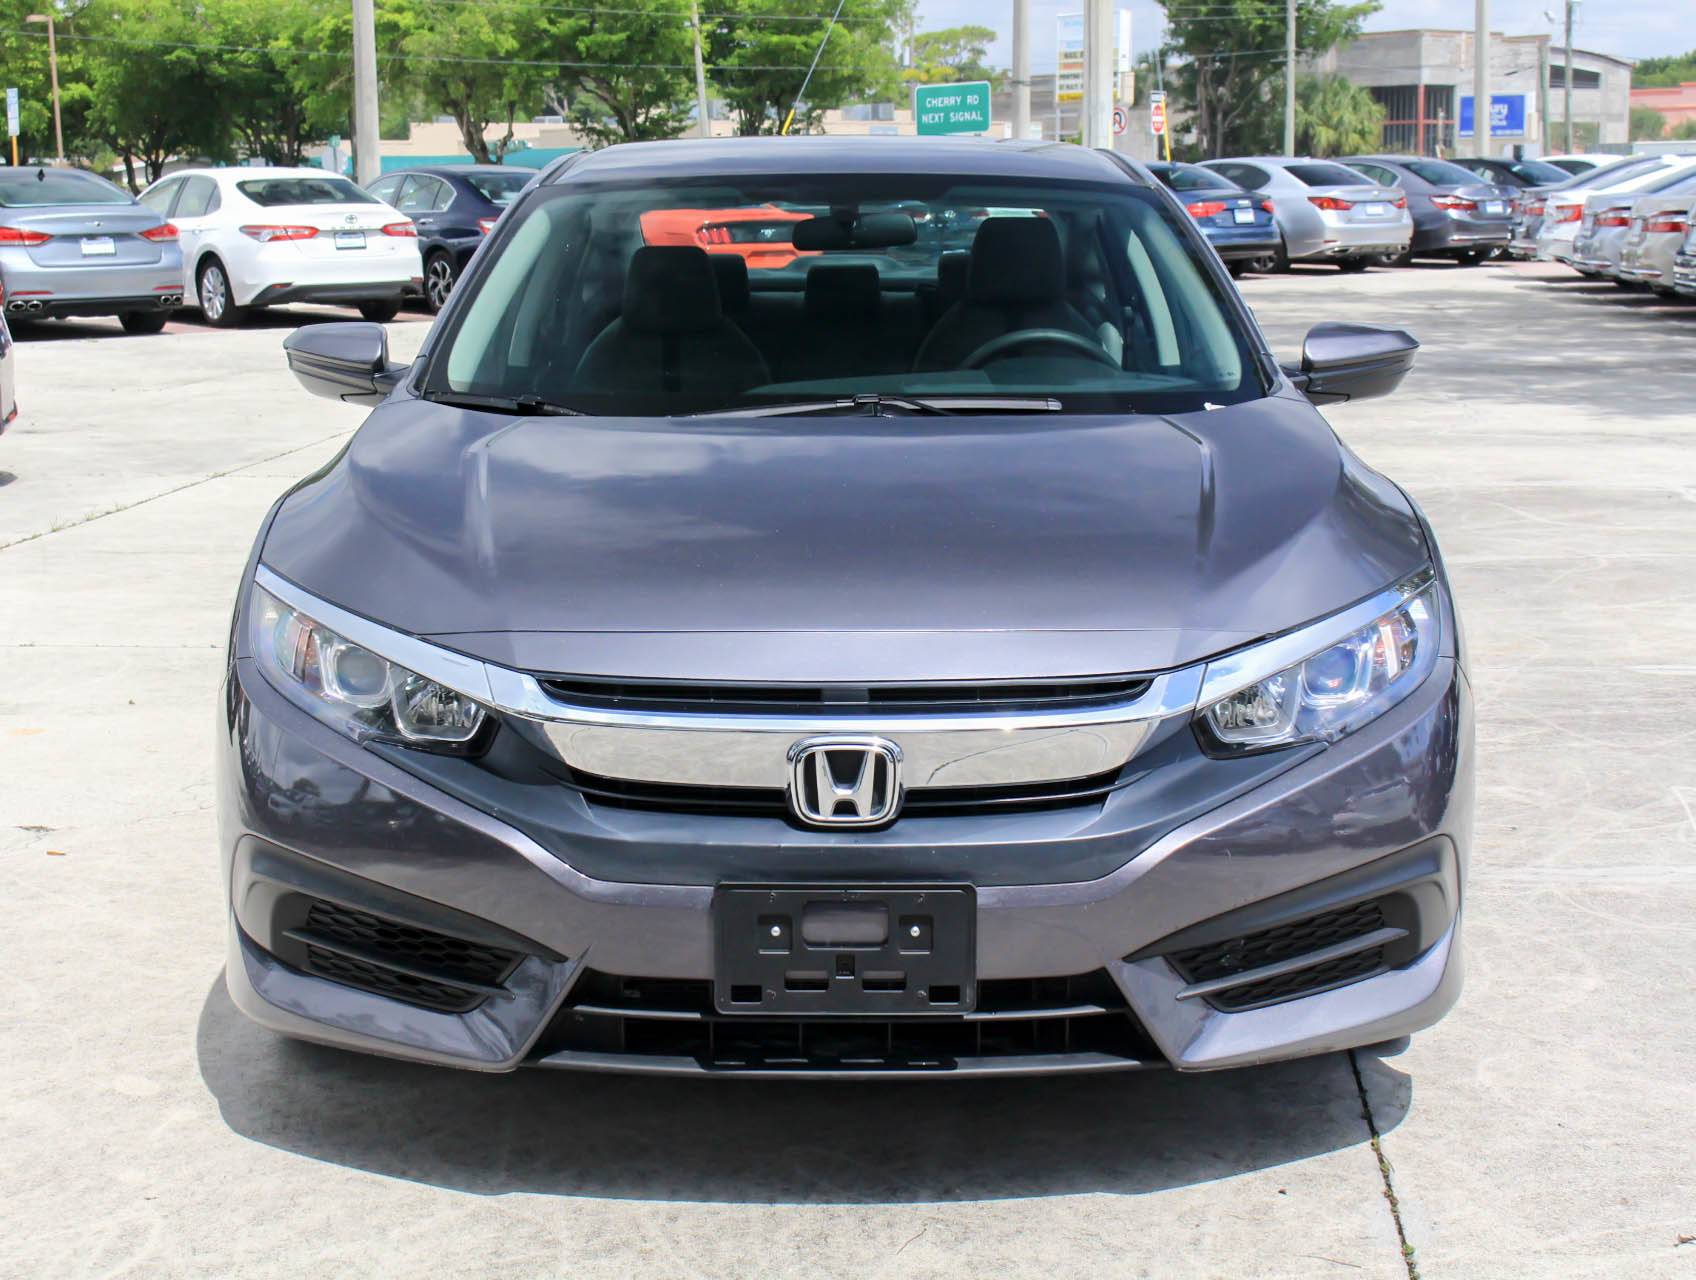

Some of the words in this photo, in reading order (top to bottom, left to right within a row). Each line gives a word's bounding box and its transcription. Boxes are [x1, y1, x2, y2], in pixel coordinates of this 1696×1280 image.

[926, 95, 962, 108] CHERRY
[967, 94, 980, 105] RD
[922, 113, 945, 124] NEXT
[949, 111, 983, 123] SIGNAL
